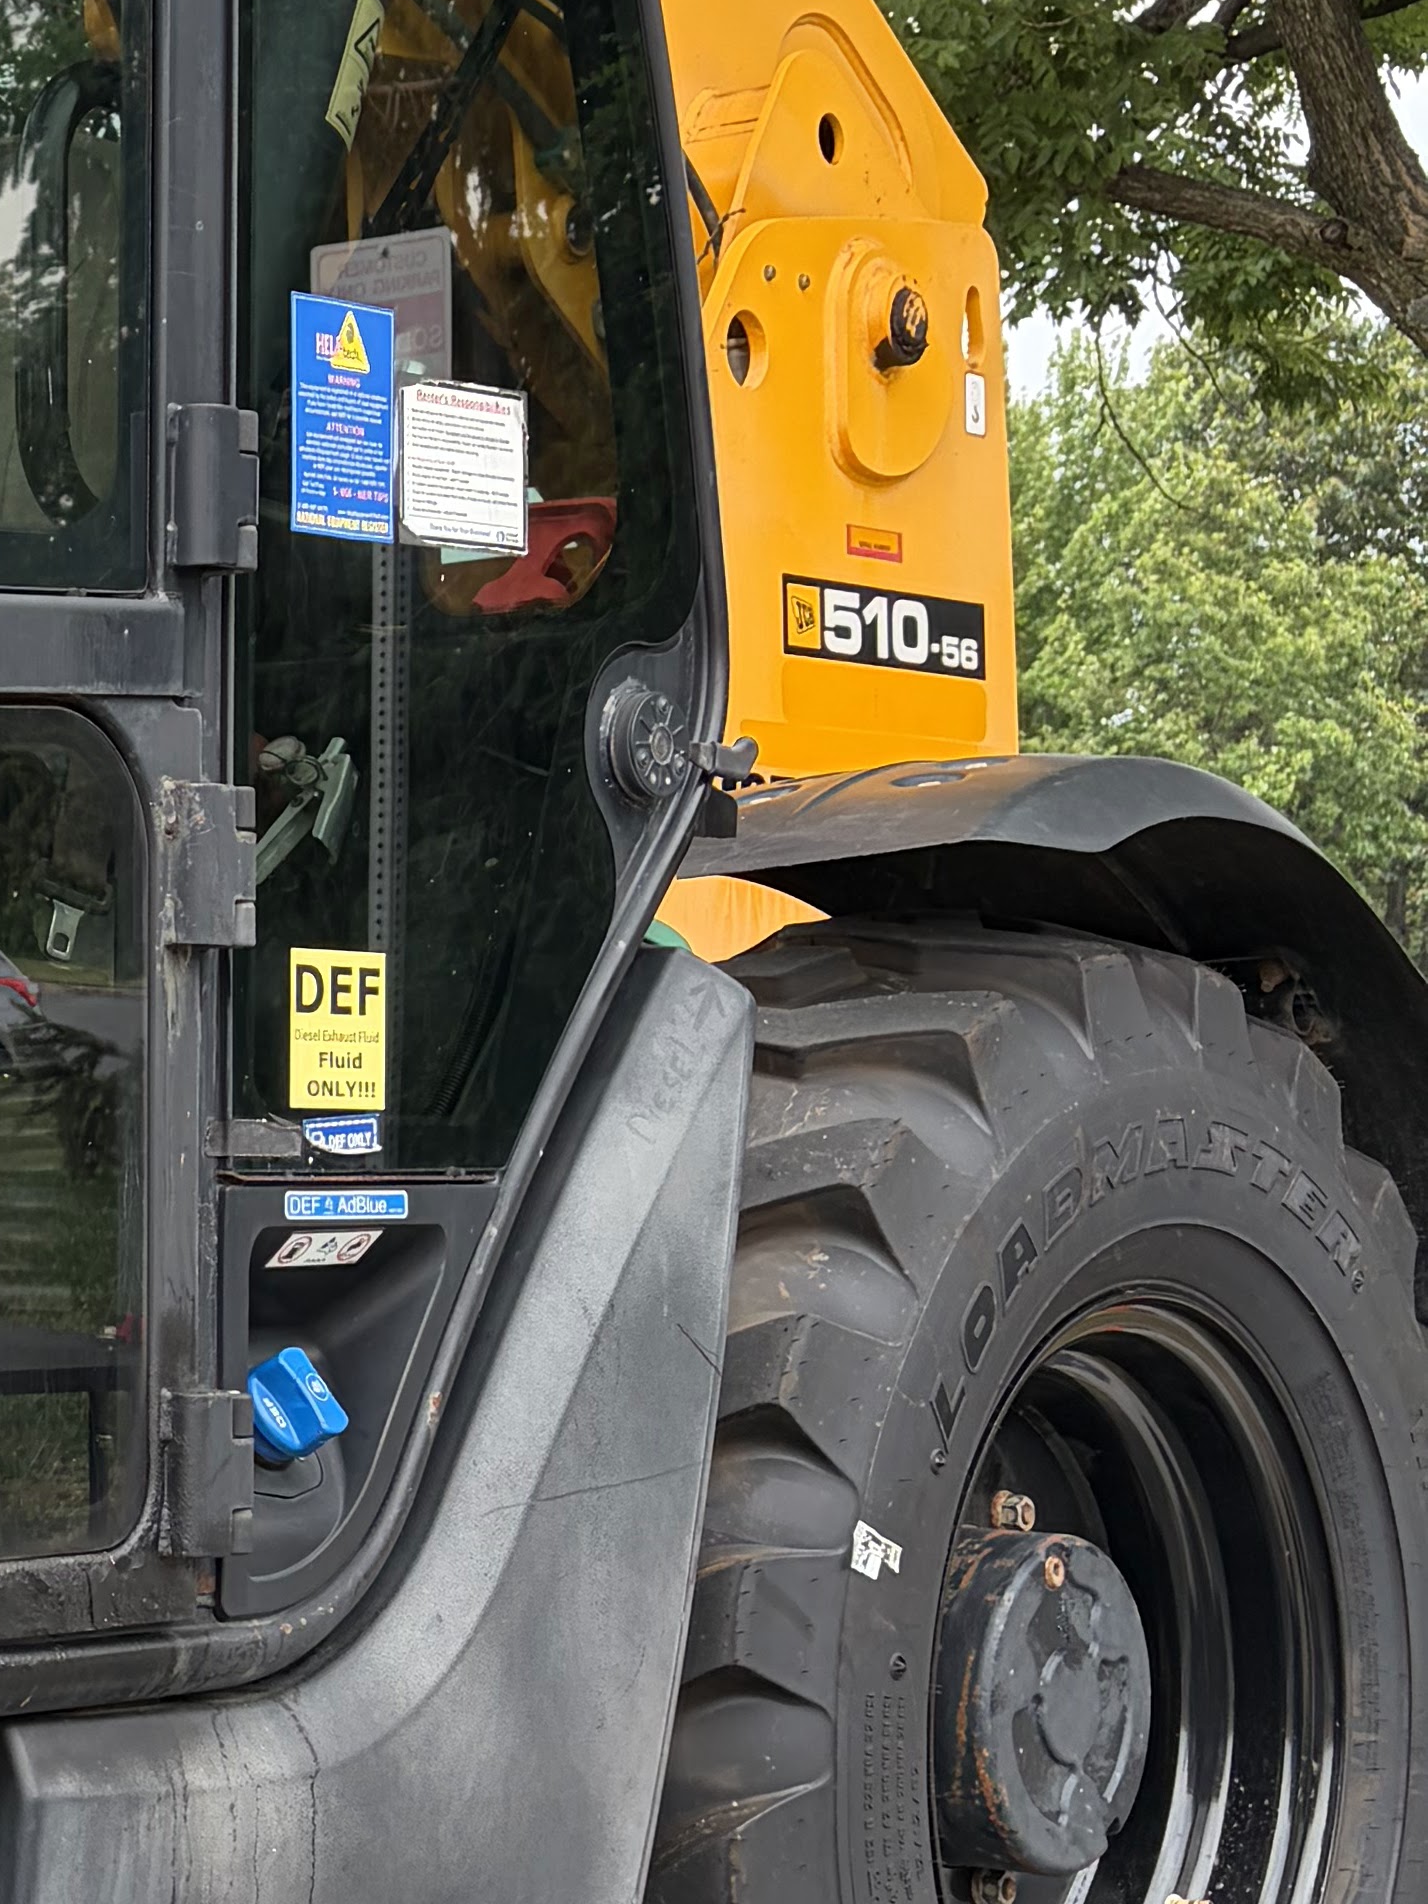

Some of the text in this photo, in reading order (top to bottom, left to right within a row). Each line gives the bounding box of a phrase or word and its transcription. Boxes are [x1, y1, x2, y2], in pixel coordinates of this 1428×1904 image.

[296, 963, 380, 1015] DEF
[294, 1028, 379, 1044] Diesel Exhaust Fluid
[319, 1052, 362, 1069] Fluid
[307, 1080, 376, 1098] ONLY!!!
[290, 1196, 321, 1214] DEF
[337, 1196, 387, 1214] AdBlue
